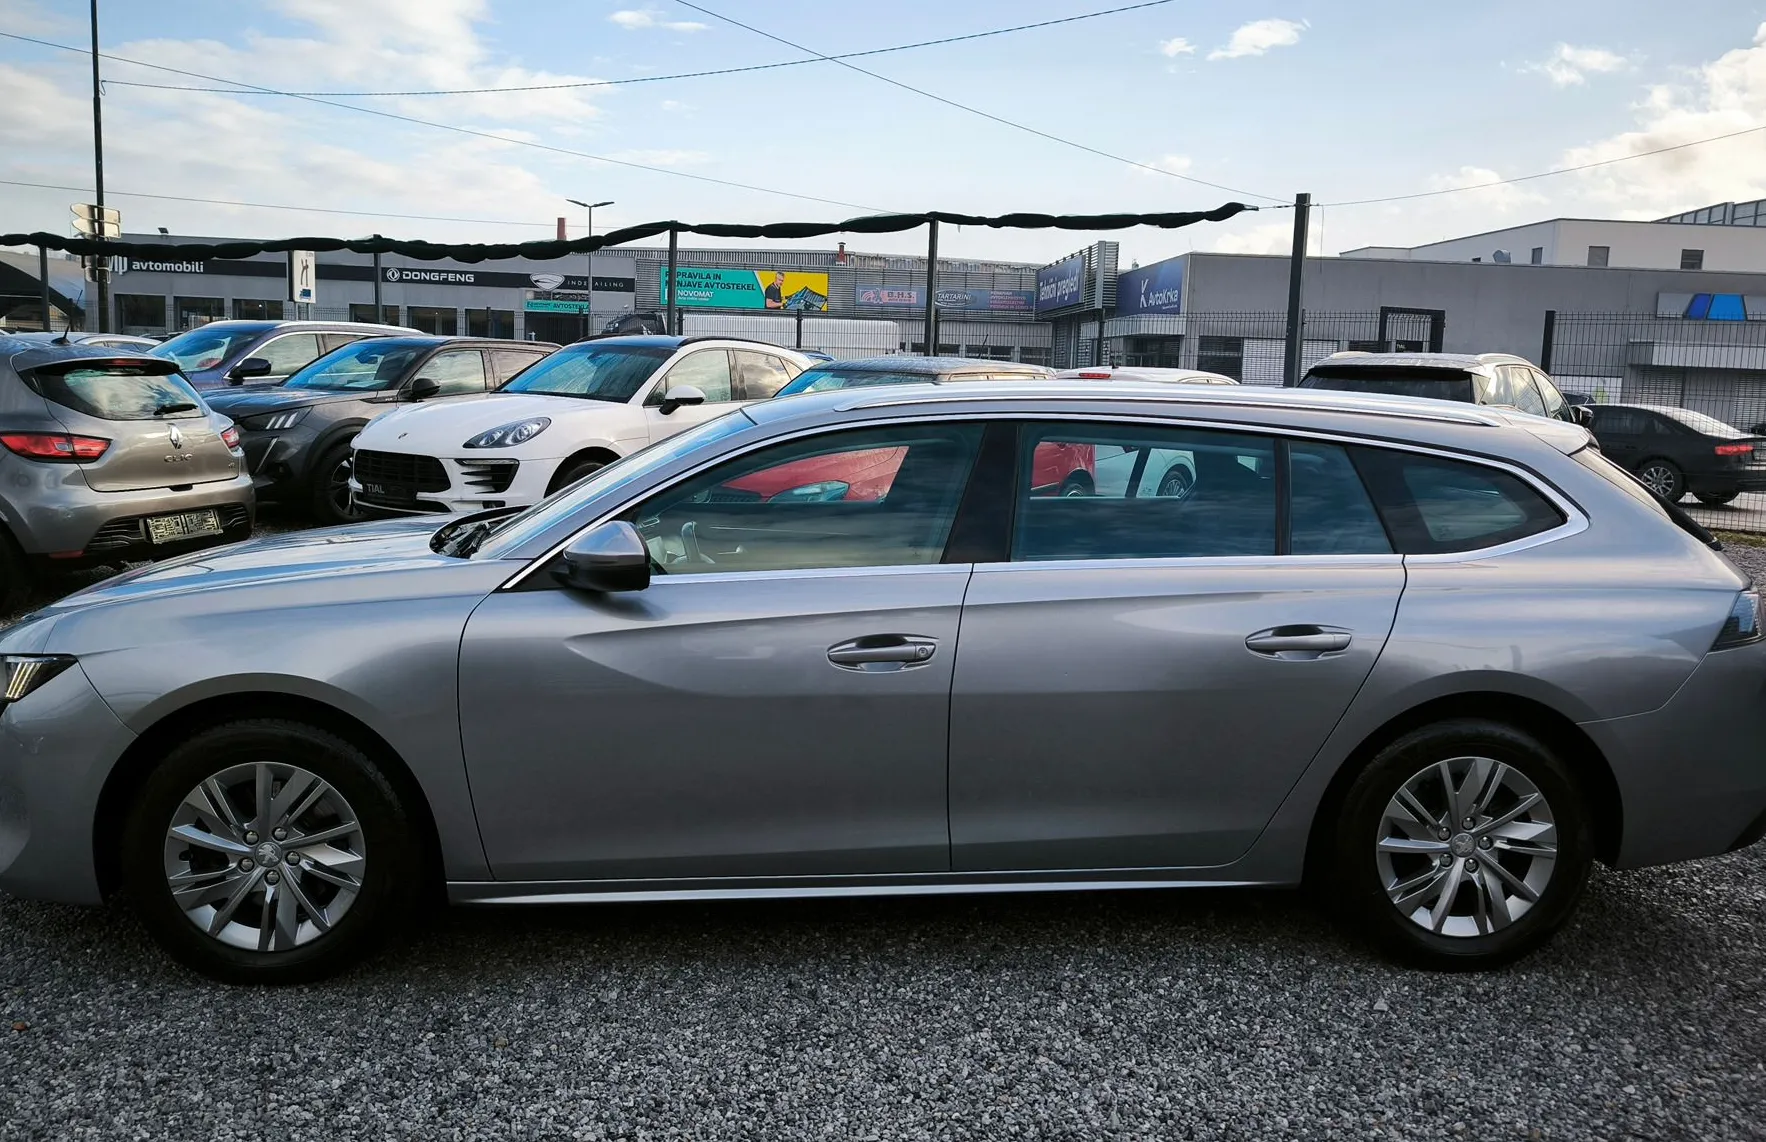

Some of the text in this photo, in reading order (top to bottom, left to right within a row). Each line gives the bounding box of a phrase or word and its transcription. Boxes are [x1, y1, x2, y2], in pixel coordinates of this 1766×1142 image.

[132, 261, 204, 273] avtomobili
[402, 271, 475, 283] DONGFENG
[665, 271, 711, 280] PPRAVILA
[567, 280, 624, 288] INDEAILING
[704, 282, 756, 291] AVTOSTEKEL
[677, 290, 714, 298] NOVOMAT
[887, 291, 915, 299] B.H.S.
